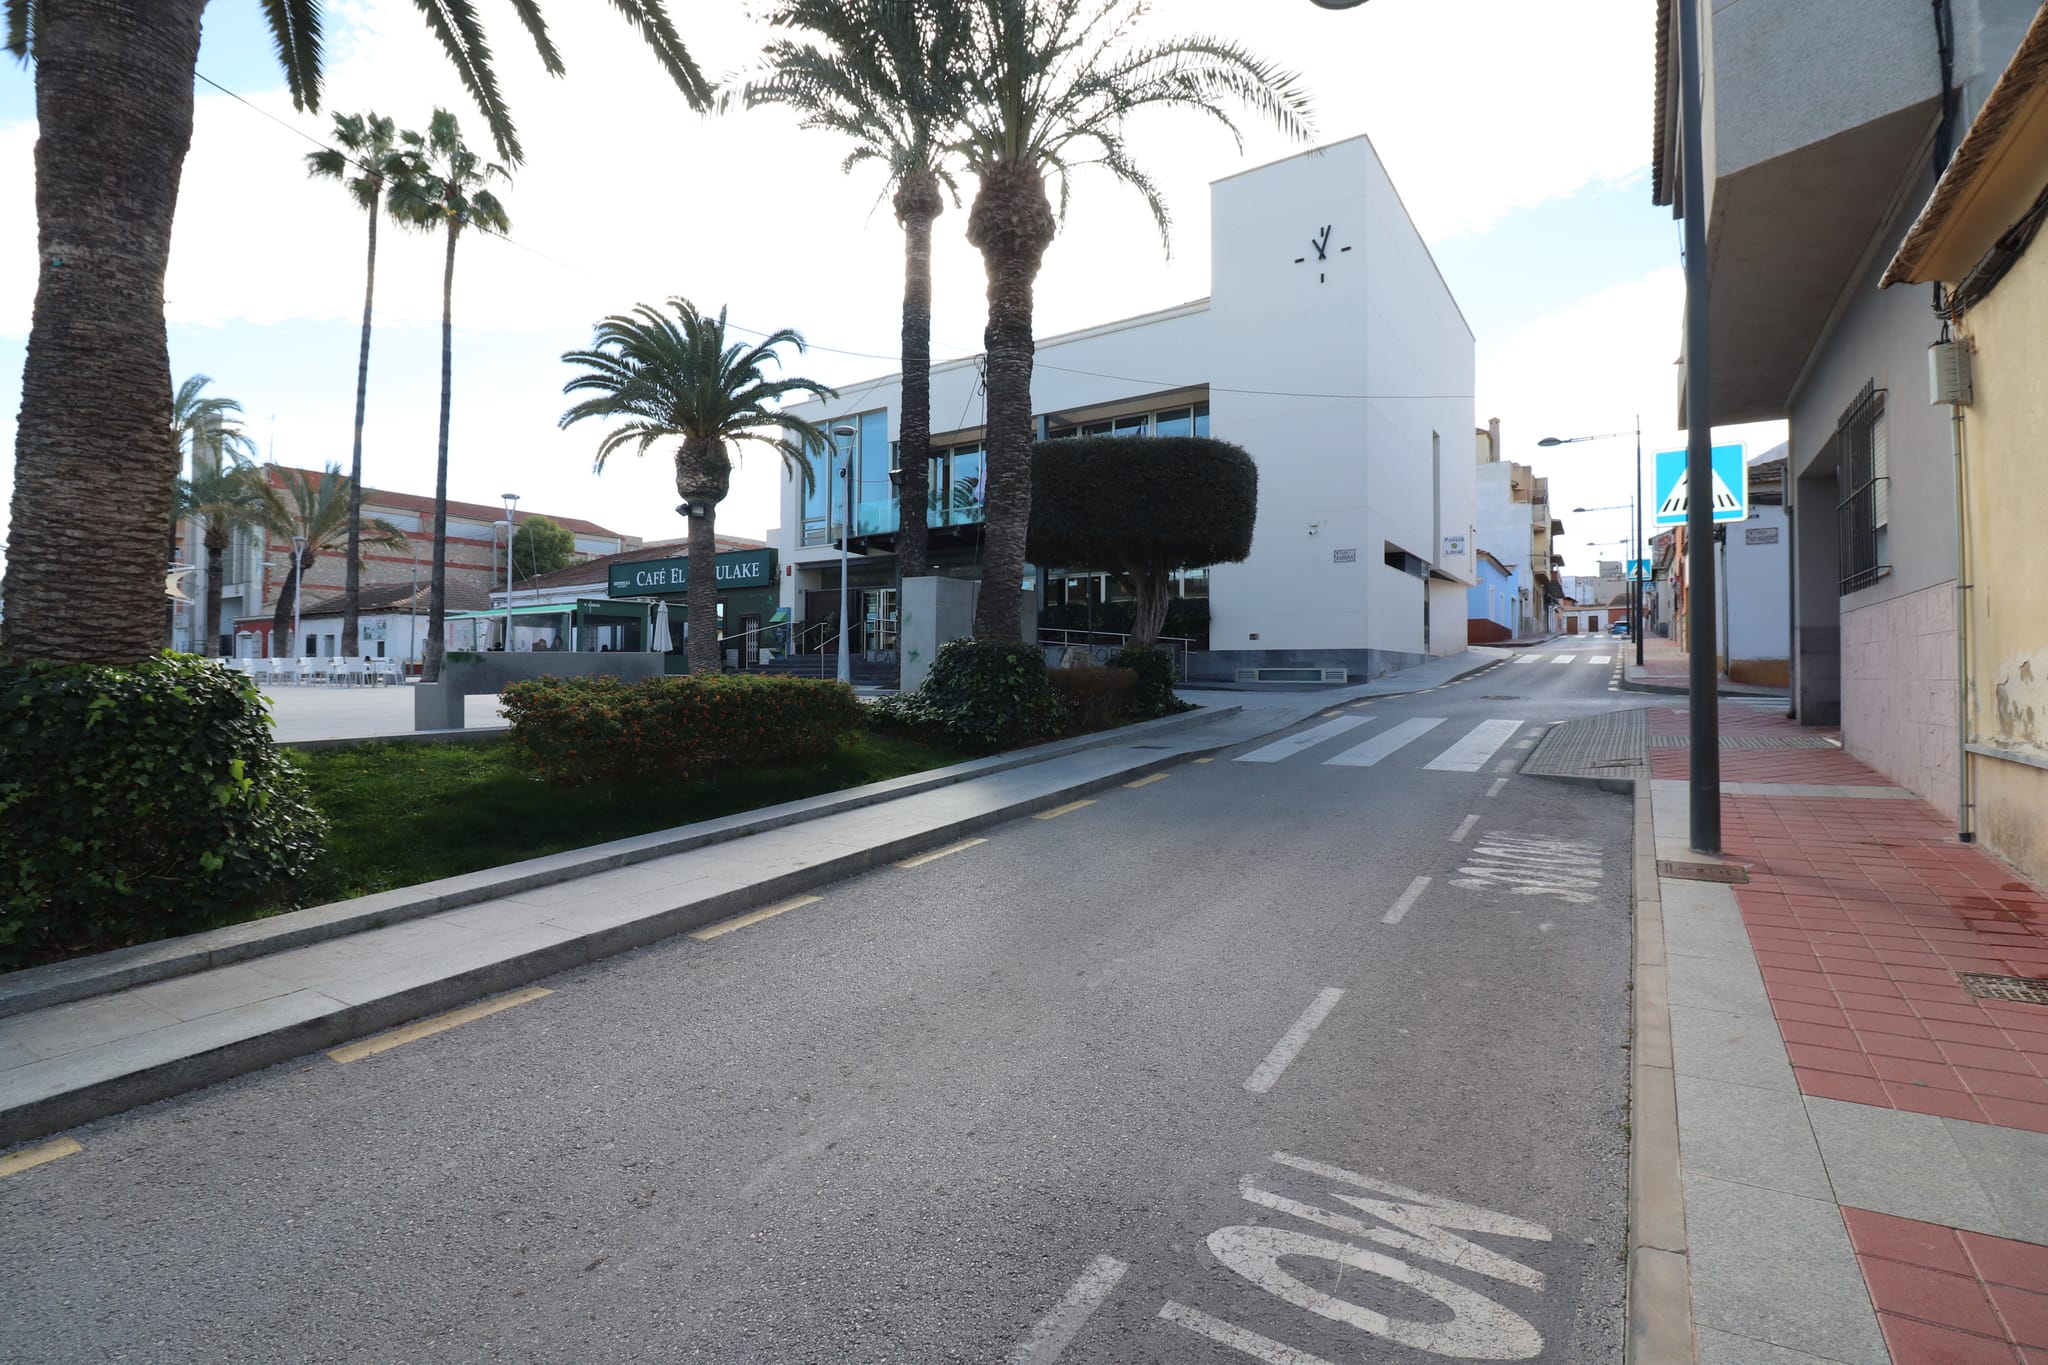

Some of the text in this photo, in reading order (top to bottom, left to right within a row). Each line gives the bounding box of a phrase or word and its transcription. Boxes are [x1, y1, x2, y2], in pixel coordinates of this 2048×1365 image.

[636, 567, 666, 587] CAFÉ
[671, 567, 686, 584] EL
[715, 562, 760, 580] ULAKE
